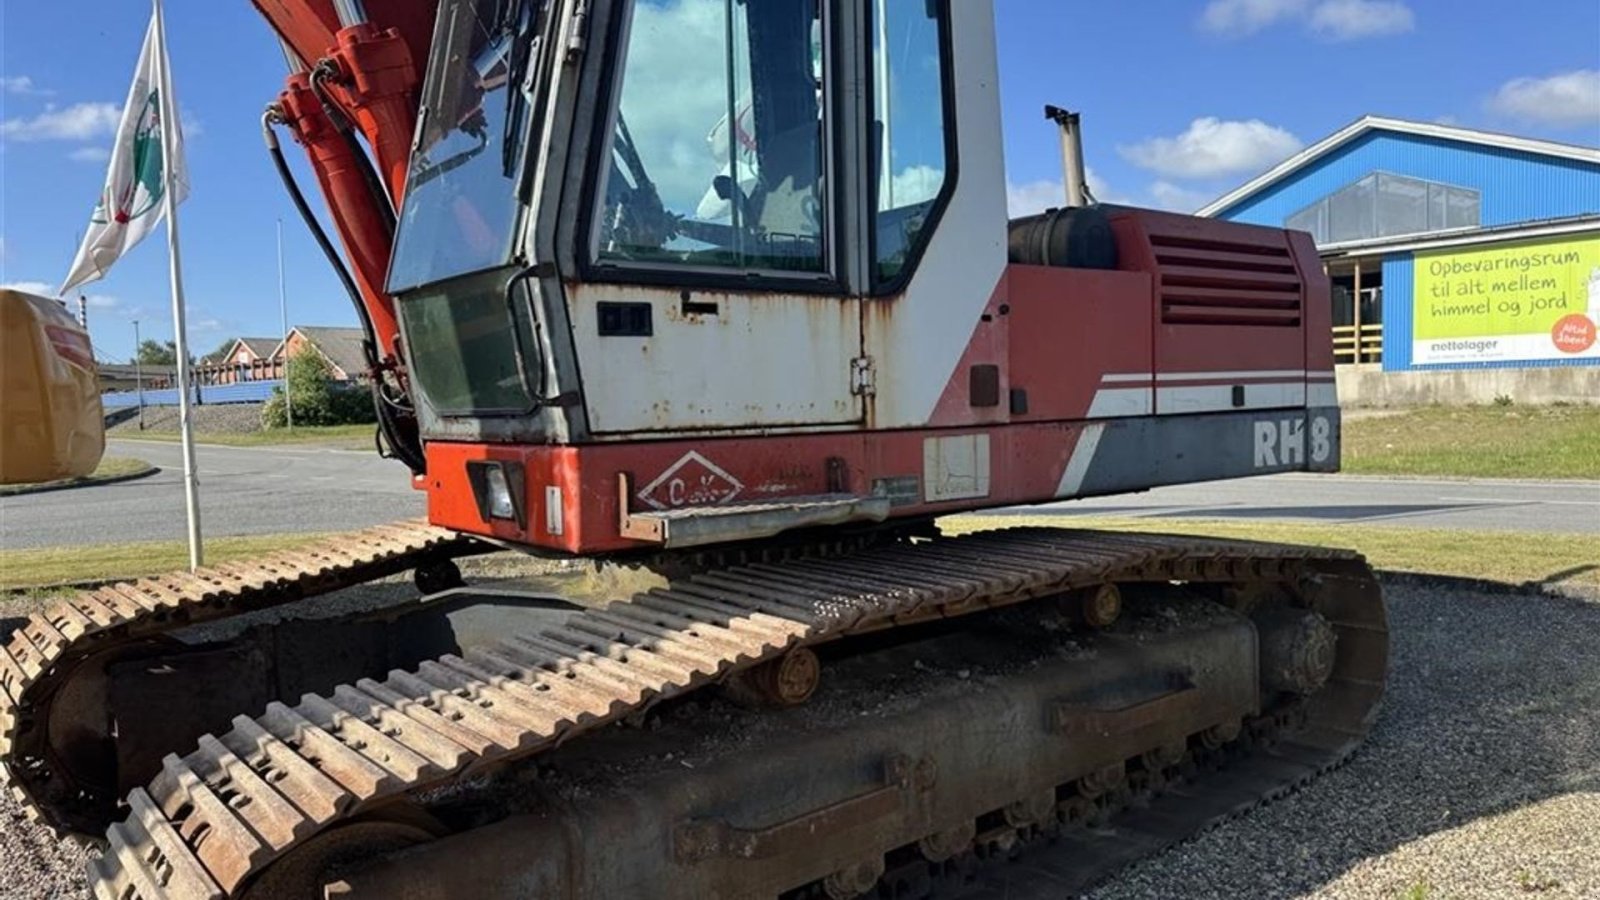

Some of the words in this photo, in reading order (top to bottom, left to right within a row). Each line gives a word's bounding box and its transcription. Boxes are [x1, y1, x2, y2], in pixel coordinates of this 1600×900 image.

[1430, 251, 1580, 278] Opbevaringsrum
[1431, 281, 1450, 298] til
[1456, 279, 1485, 296] alt
[1492, 274, 1556, 293] mellem
[1431, 298, 1491, 317] himmel
[1498, 301, 1521, 317] og
[1528, 291, 1567, 315] jord
[1431, 340, 1499, 352] nettolager
